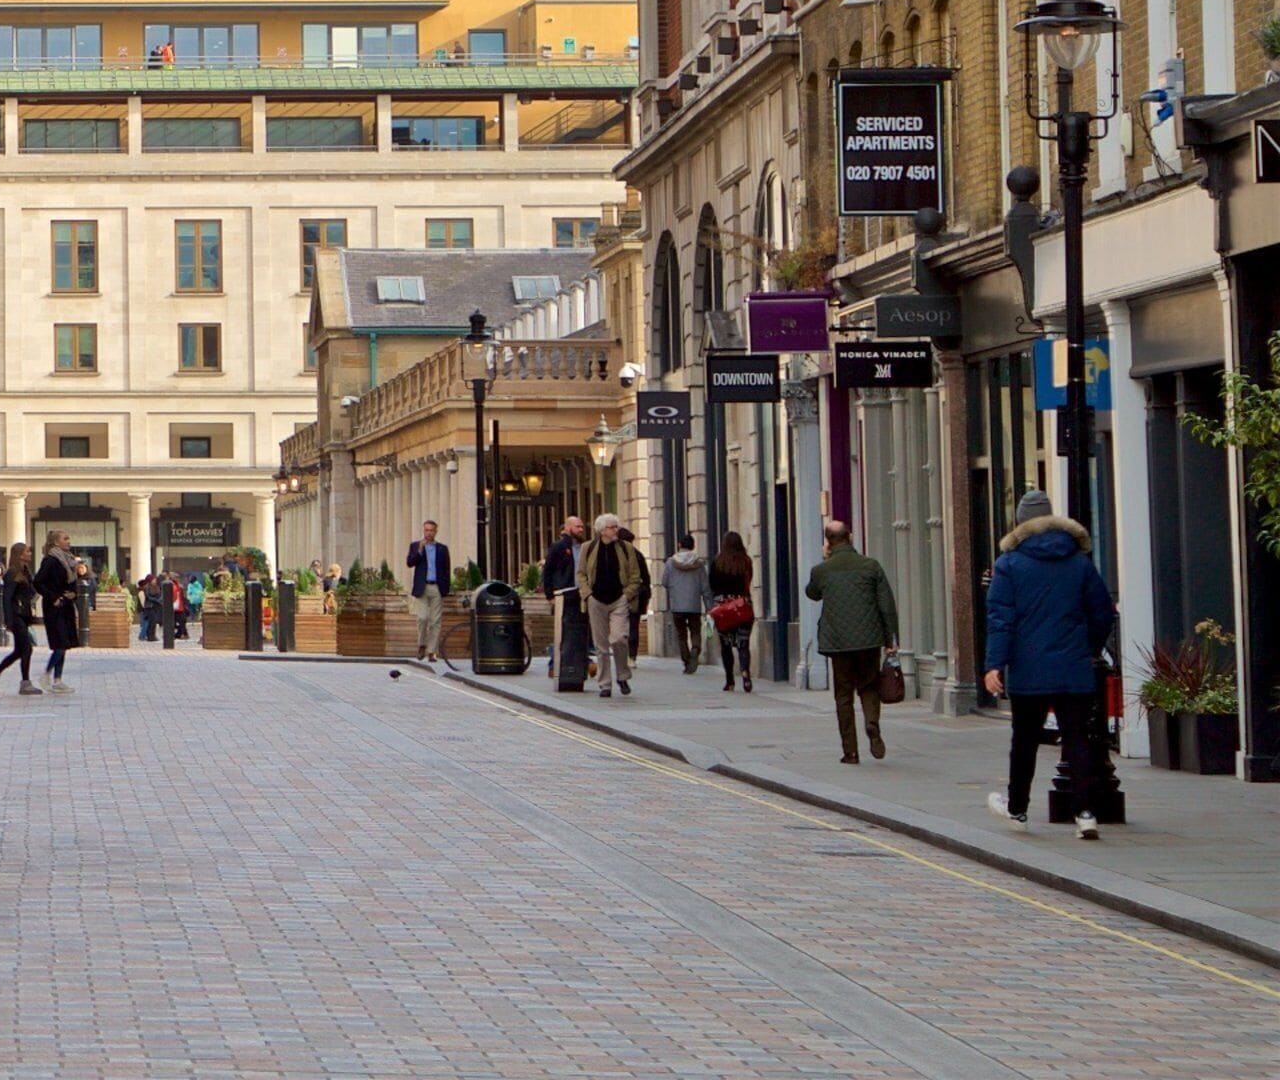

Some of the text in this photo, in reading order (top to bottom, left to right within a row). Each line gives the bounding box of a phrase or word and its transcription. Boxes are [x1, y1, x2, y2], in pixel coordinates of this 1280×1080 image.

[856, 116, 924, 132] SERVICED
[846, 135, 935, 151] APARTMENTS
[846, 165, 936, 180] 020 7907 4501
[890, 307, 951, 326] Aesop
[713, 373, 773, 386] DOWNTOWN
[171, 528, 224, 537] TOM DAVIES
